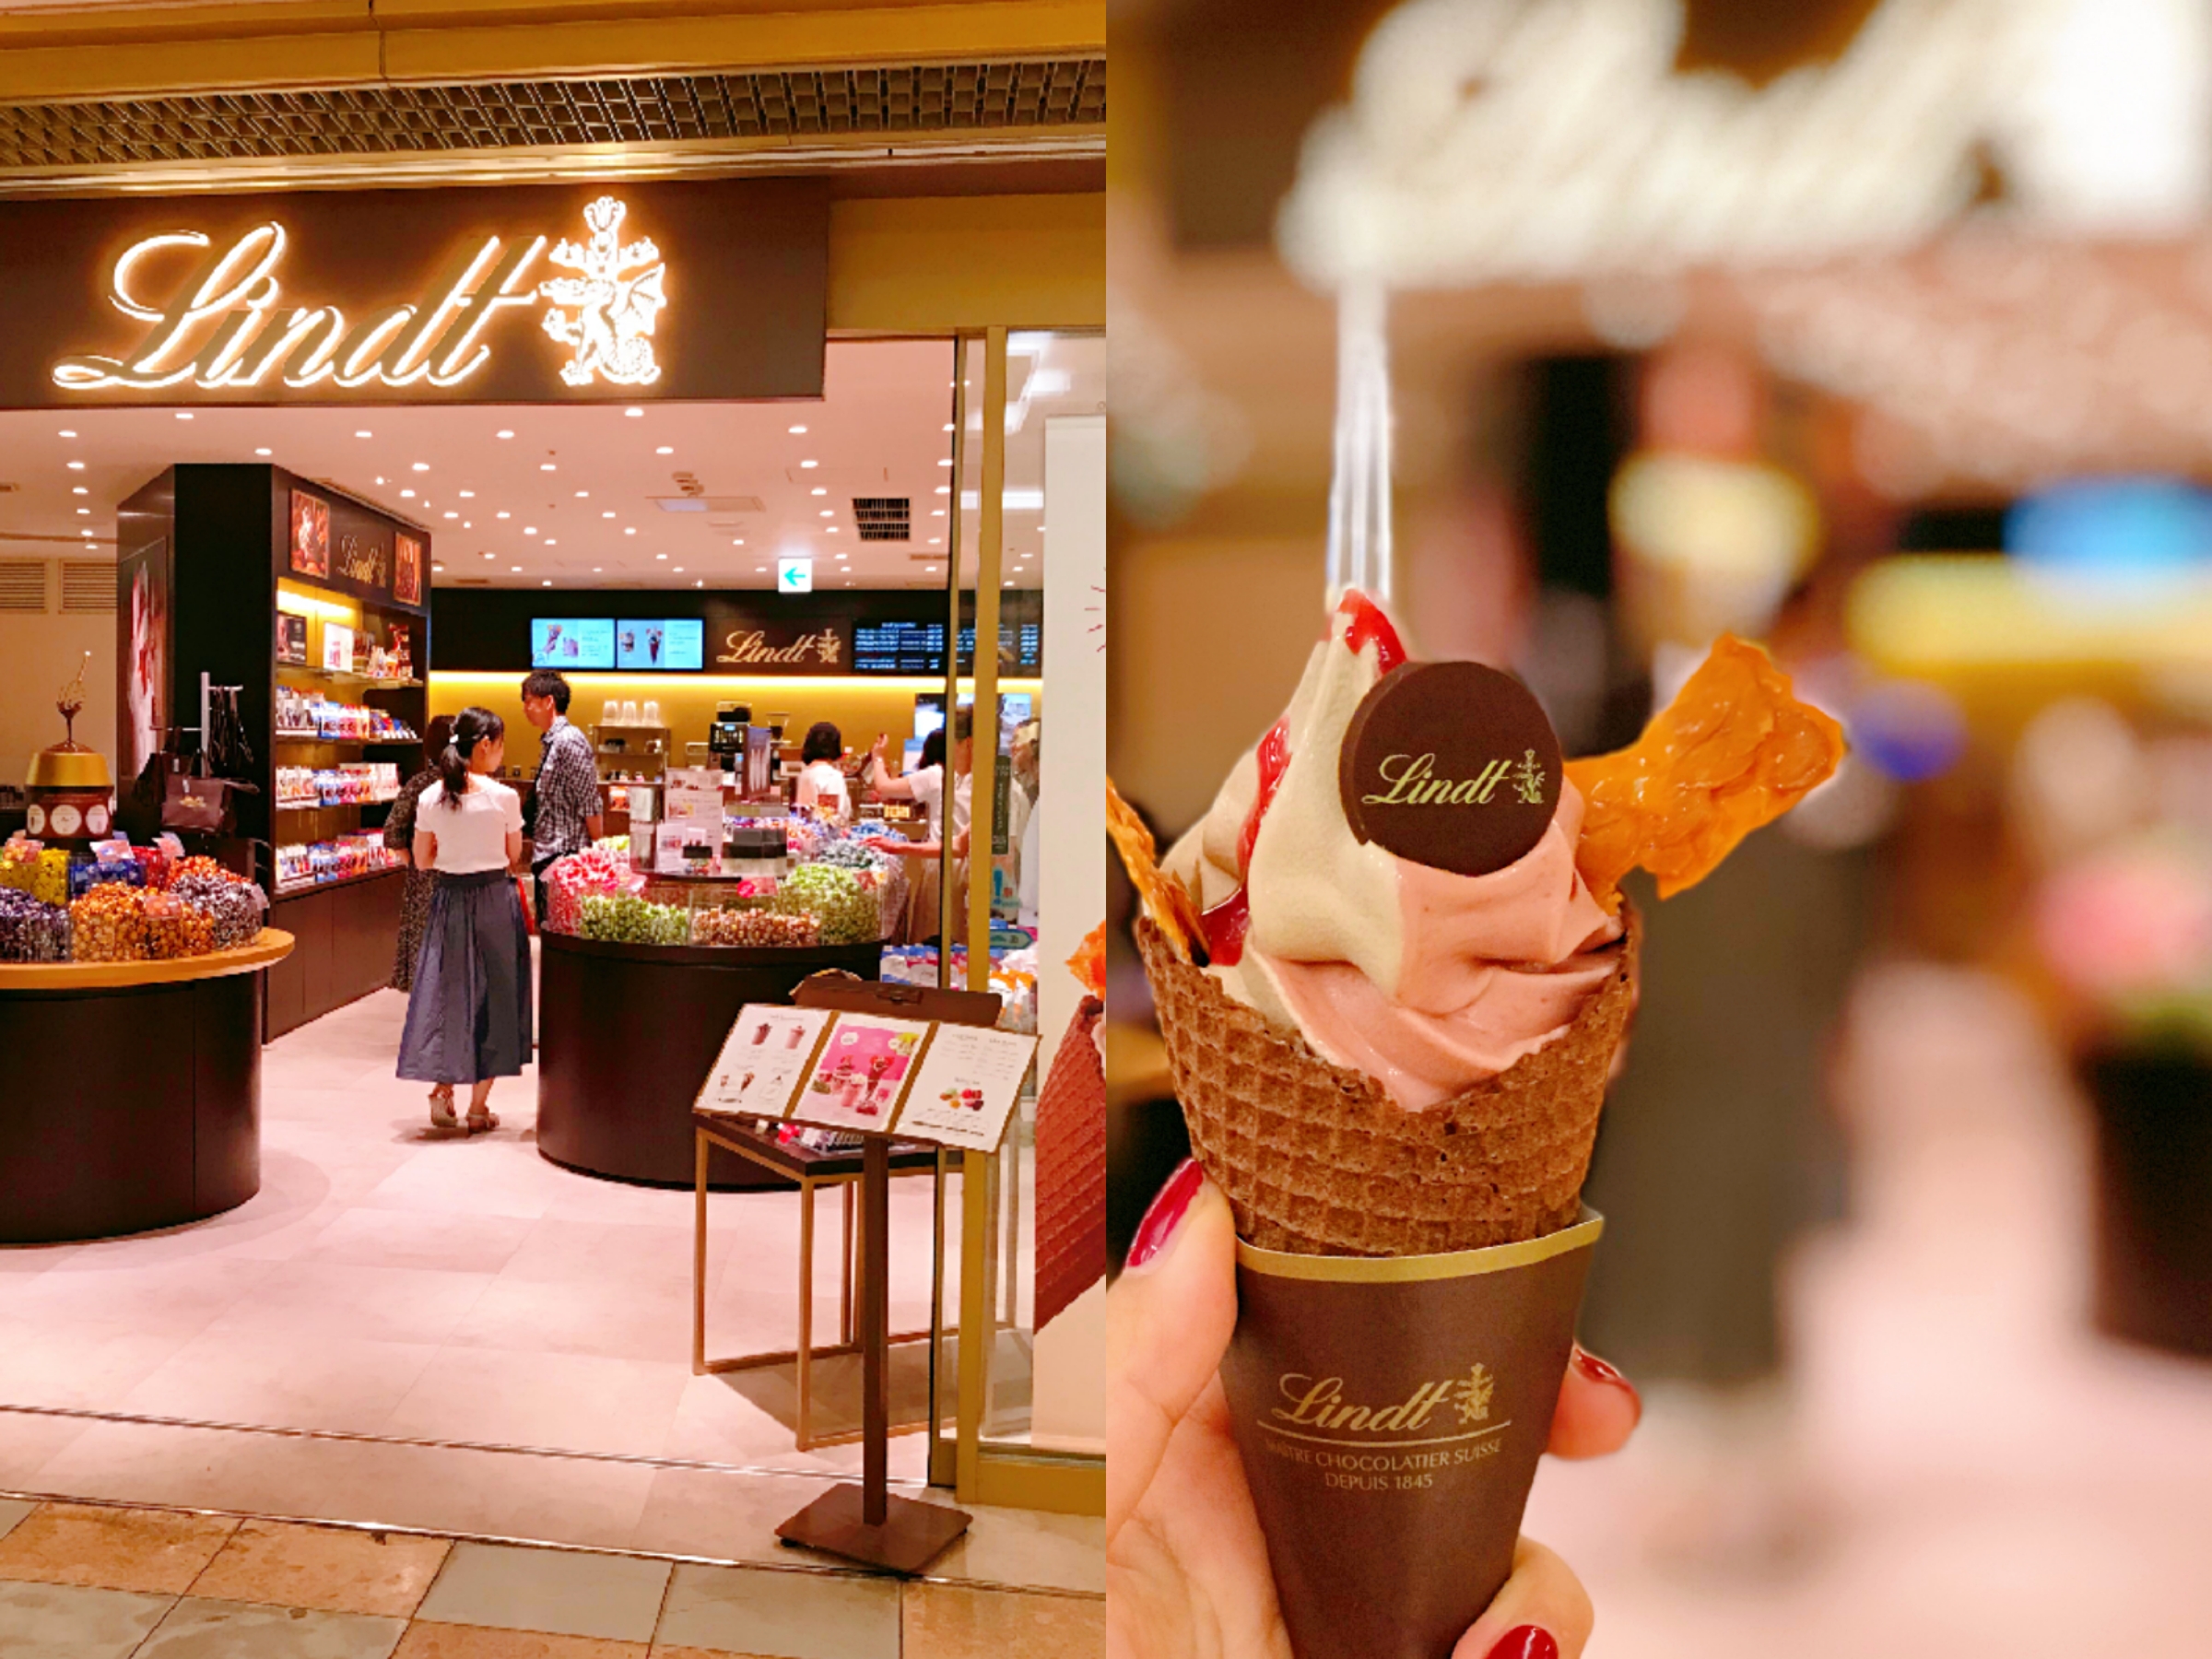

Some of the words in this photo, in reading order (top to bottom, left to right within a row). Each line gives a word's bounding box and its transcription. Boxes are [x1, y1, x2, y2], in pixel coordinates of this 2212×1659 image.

[52, 219, 547, 390] Lindt
[715, 629, 817, 664] Lindt
[1359, 752, 1512, 806] Lindt
[1270, 1372, 1454, 1432] Lindt
[1265, 1438, 1312, 1465] TRE
[1315, 1450, 1450, 1472] CHOCOLATIER
[1453, 1438, 1502, 1465] SUISSE
[1324, 1472, 1389, 1491] DEPUIS
[1394, 1473, 1433, 1490] 1845
